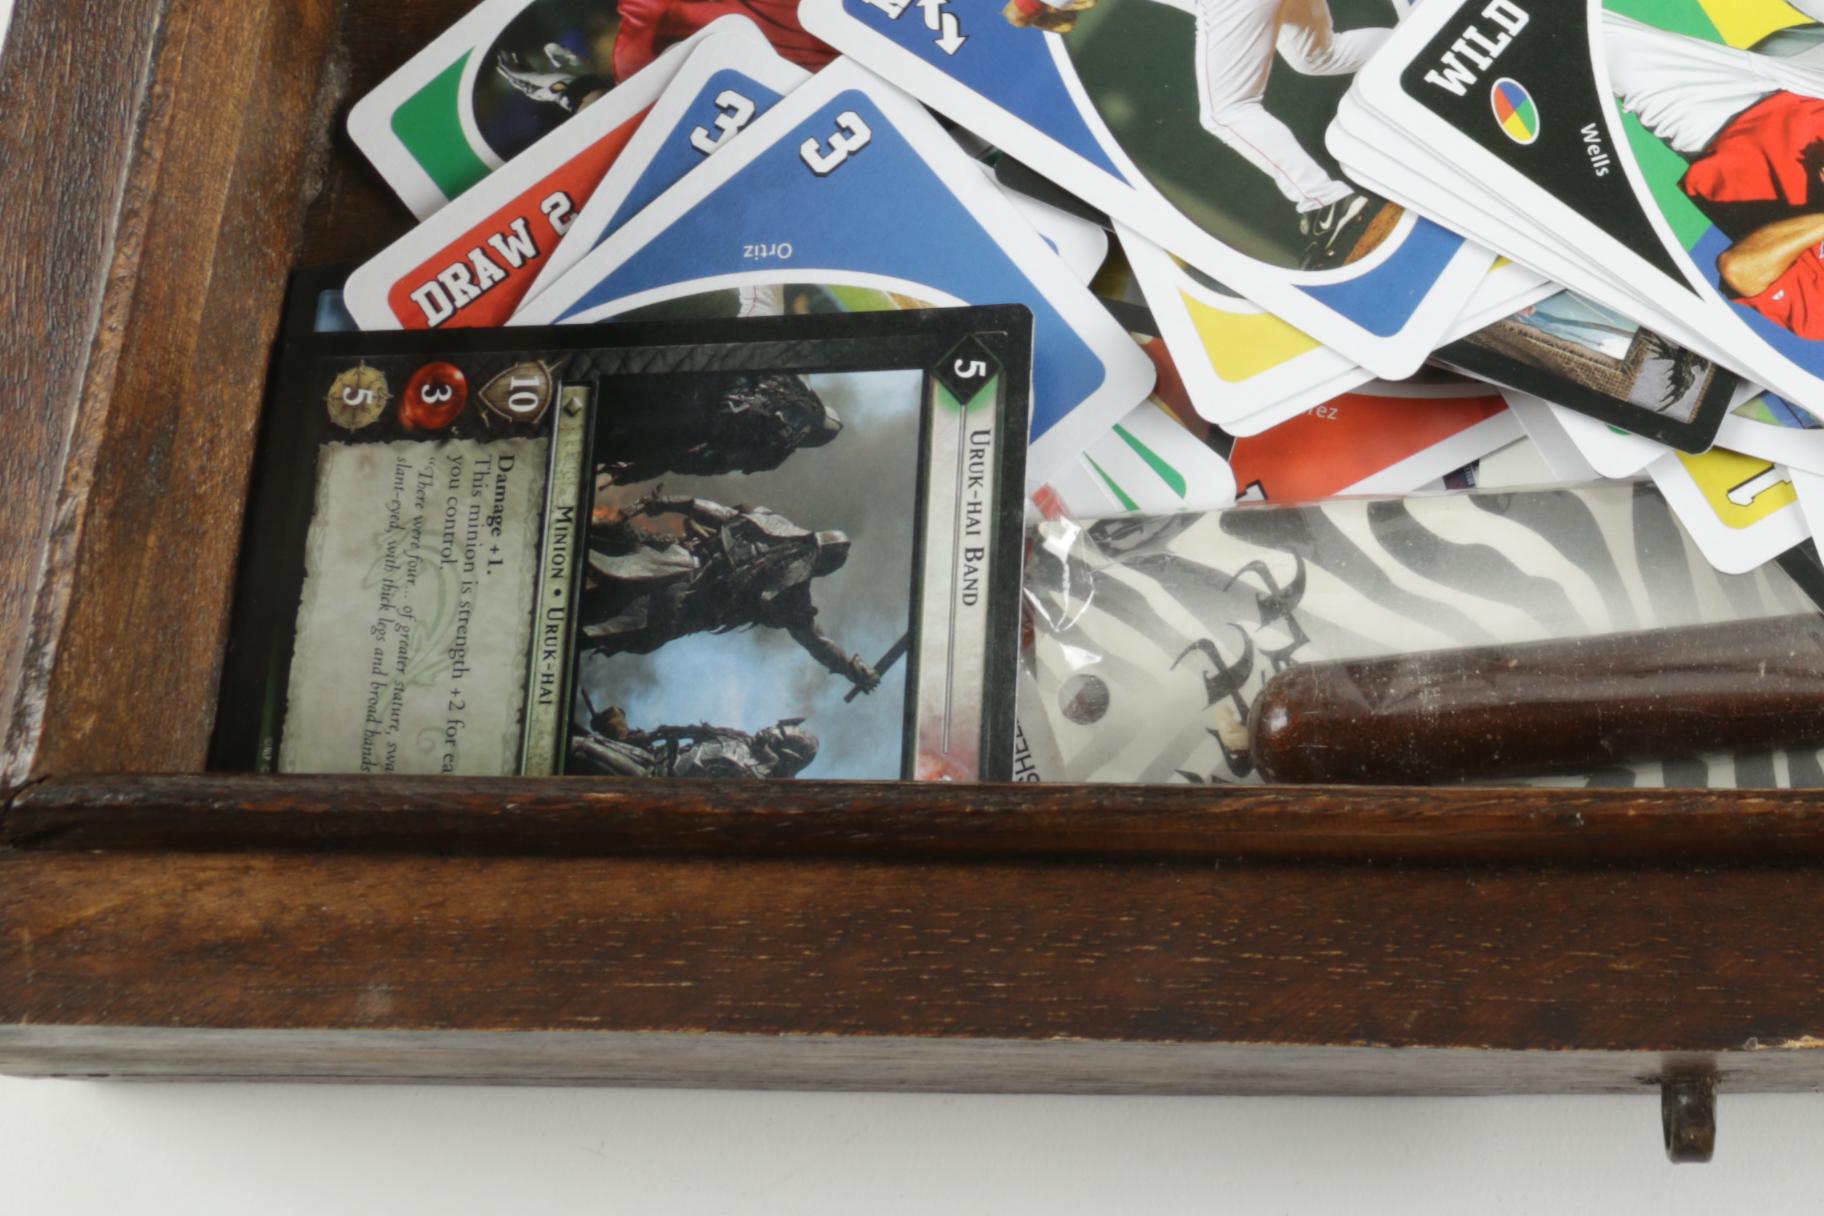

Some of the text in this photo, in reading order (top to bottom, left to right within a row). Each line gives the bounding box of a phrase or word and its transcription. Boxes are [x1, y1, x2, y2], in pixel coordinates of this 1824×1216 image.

[690, 89, 756, 156] 3
[799, 109, 873, 179] 3
[1579, 121, 1611, 178] Wells
[409, 190, 578, 329] DRAW 2
[743, 241, 793, 261] Ortiz
[421, 382, 451, 406] 3
[509, 374, 540, 415] 10
[951, 356, 987, 382] 5
[342, 384, 374, 410] 5
[472, 453, 493, 497] This
[410, 515, 424, 549] were
[439, 455, 463, 570] you control.
[463, 504, 483, 572] minion
[486, 453, 515, 575] Damage +1.
[962, 429, 991, 606] URUK-HAI BAND
[397, 605, 415, 619] of
[461, 581, 478, 594] is
[538, 505, 575, 706] MINION URUK-HAI
[360, 456, 408, 773] slant-eyed, with thick legs and broad hands
[448, 601, 471, 679] strength
[395, 624, 410, 675] greater
[385, 680, 405, 735] stature,
[448, 688, 464, 712] +2
[444, 719, 464, 747] for
